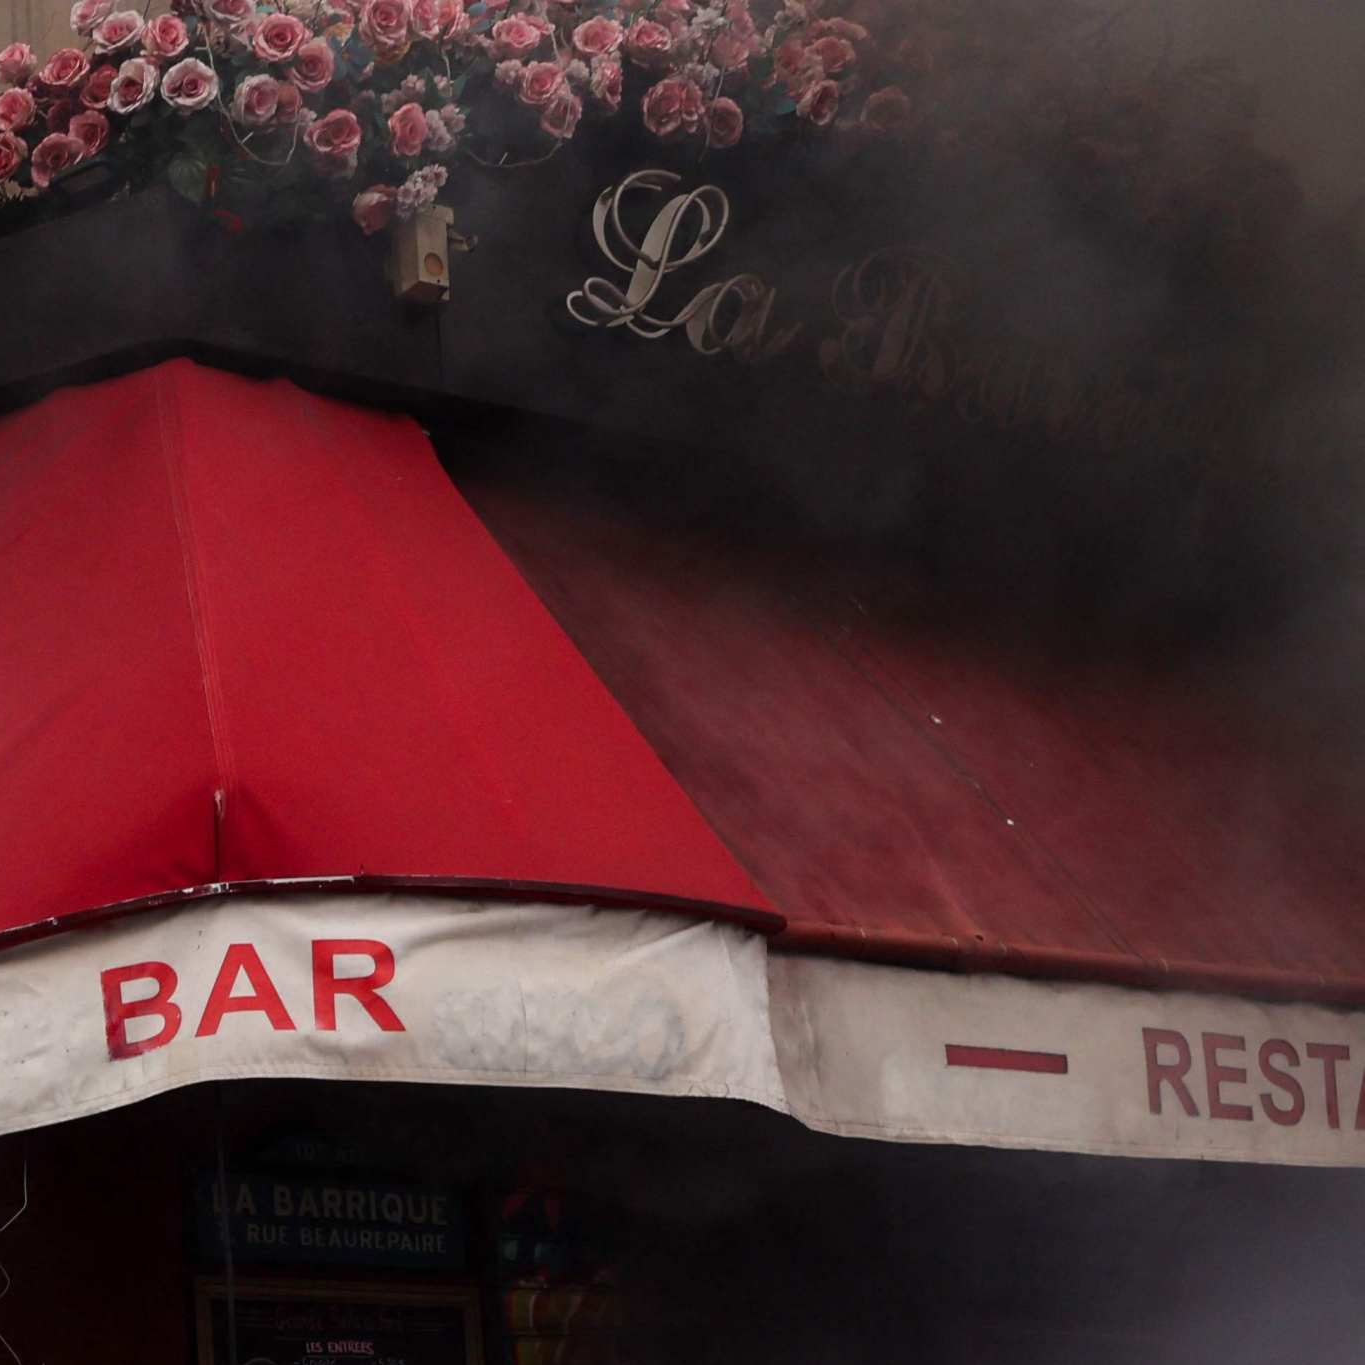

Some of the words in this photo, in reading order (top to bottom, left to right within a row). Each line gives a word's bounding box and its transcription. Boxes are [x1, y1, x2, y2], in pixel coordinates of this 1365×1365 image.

[101, 938, 407, 1059] BAR
[1141, 1026, 1365, 1131] REST
[212, 1184, 257, 1218] LA
[273, 1184, 447, 1227] BARRIQUE
[245, 1223, 288, 1247] RUE
[300, 1226, 447, 1256] BEAUREPAIRE
